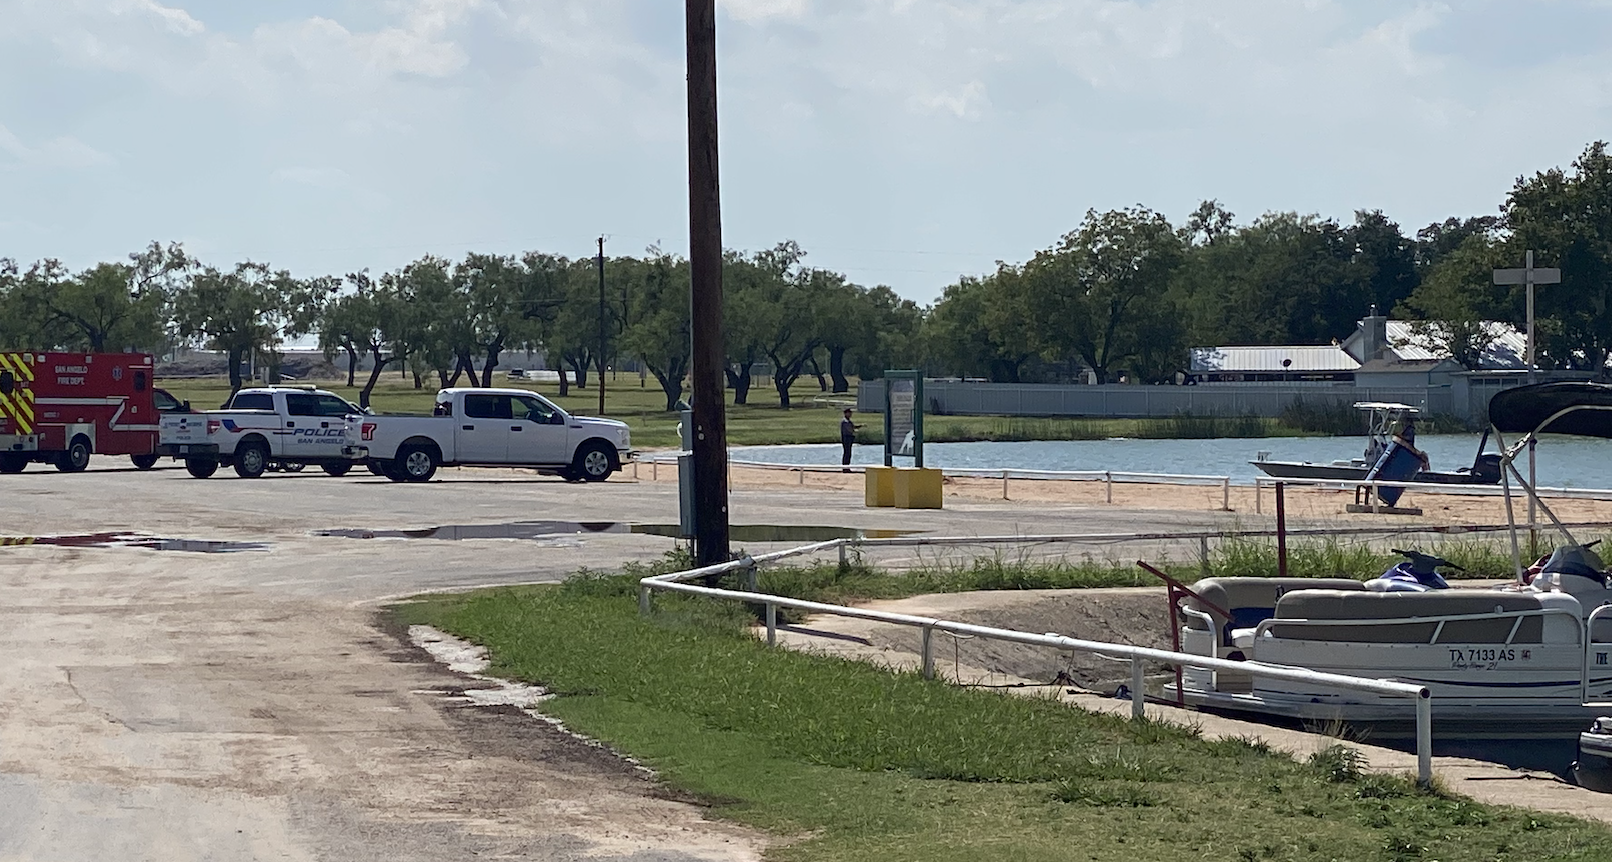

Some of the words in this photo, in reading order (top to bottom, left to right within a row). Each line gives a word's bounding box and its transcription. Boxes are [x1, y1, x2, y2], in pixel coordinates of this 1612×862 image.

[55, 365, 66, 373] SAN
[66, 365, 88, 374] ANGELO
[57, 377, 69, 385] FIRE
[293, 428, 345, 439] POLICE
[1449, 649, 1465, 661] TX
[1468, 649, 1495, 661] 7133
[1498, 649, 1515, 661] AS
